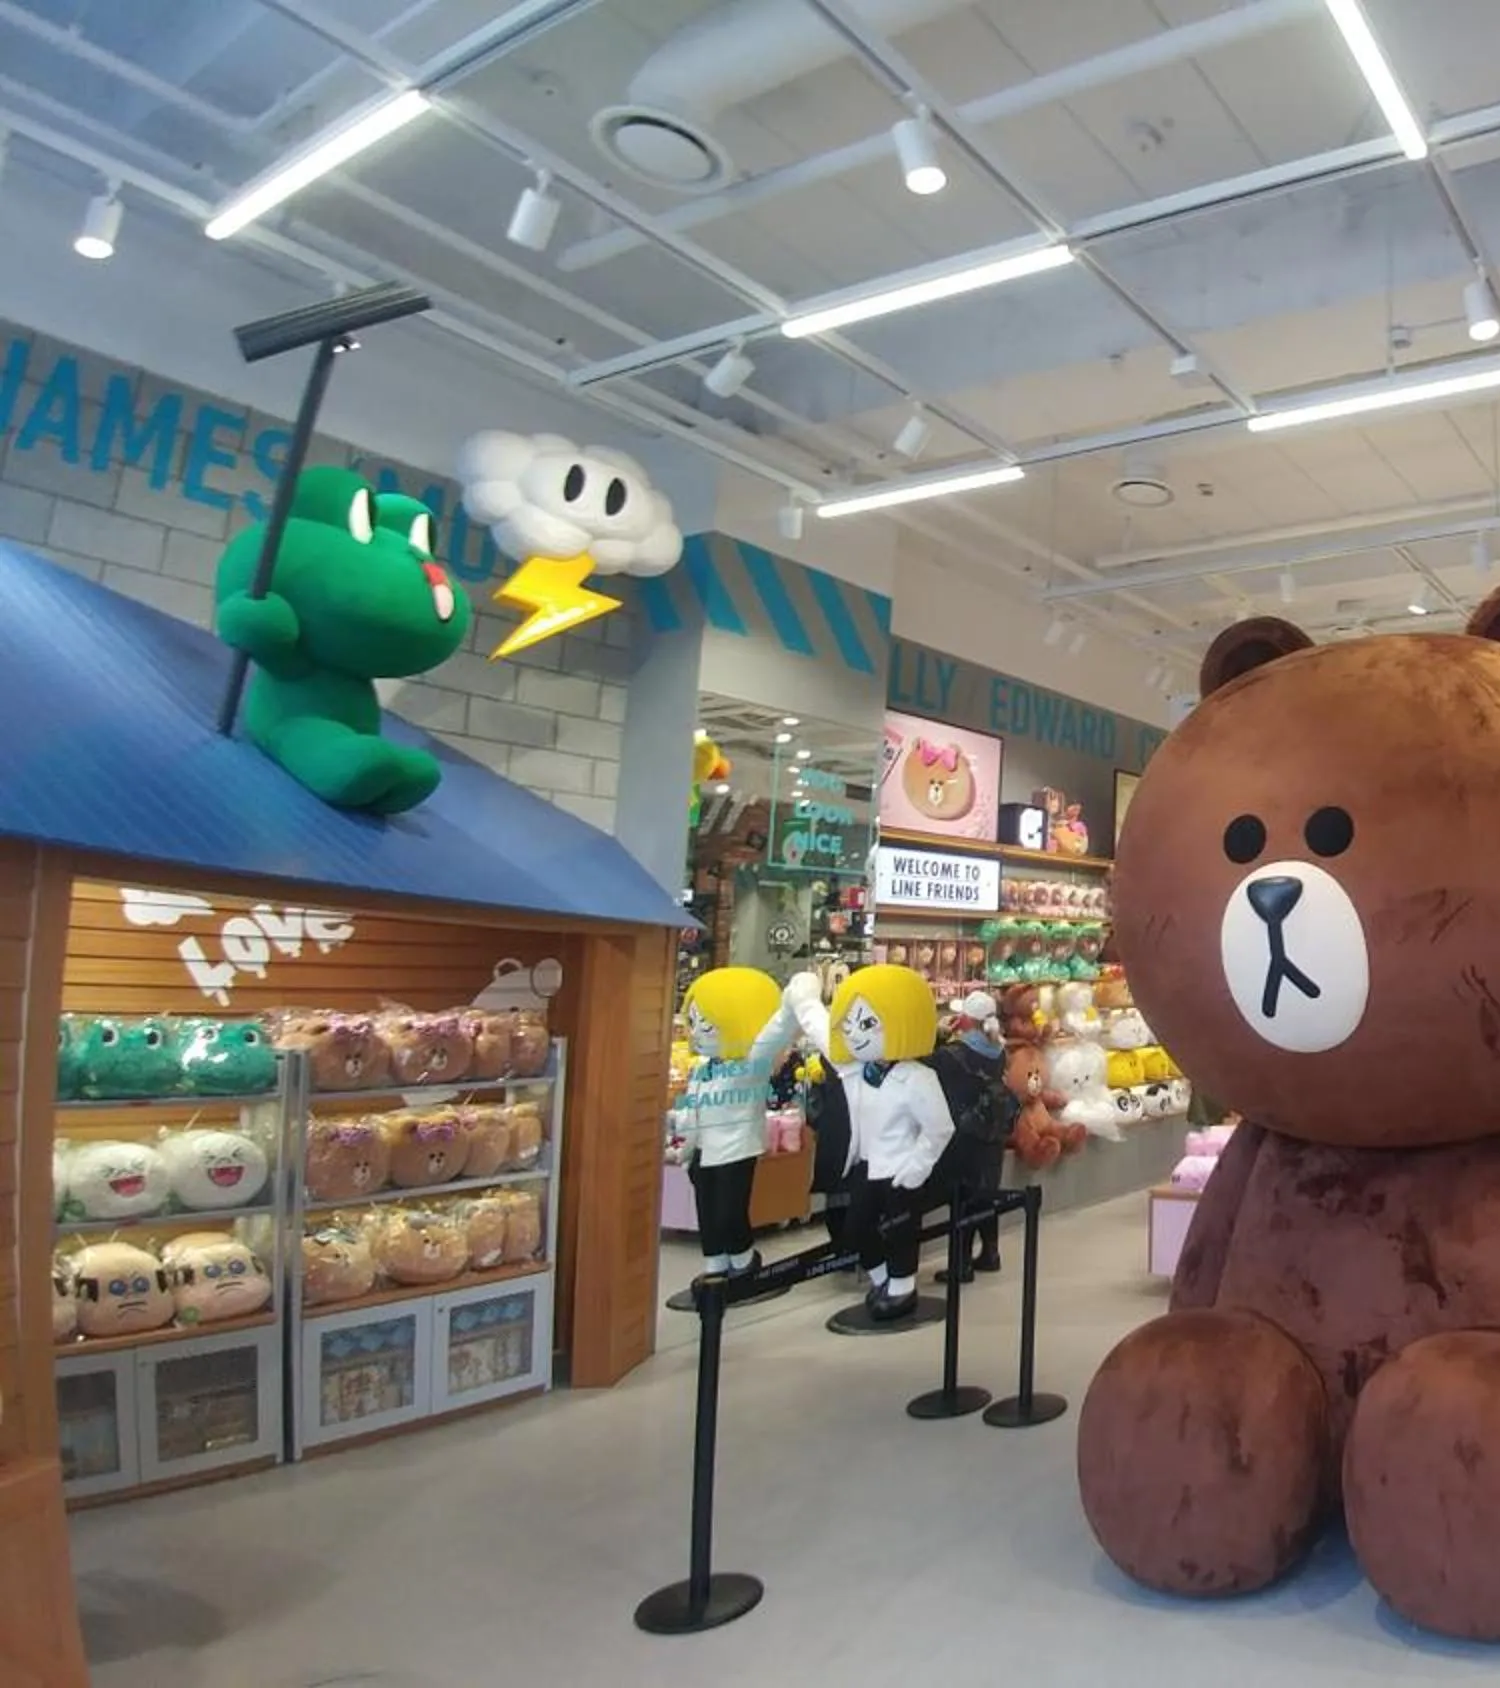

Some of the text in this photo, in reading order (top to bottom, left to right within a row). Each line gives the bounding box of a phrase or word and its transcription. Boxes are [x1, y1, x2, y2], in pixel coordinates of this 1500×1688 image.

[990, 676, 1116, 758] EDWARD
[893, 855, 981, 881] WELCOME TO
[891, 881, 980, 900] LINE FRIENDS
